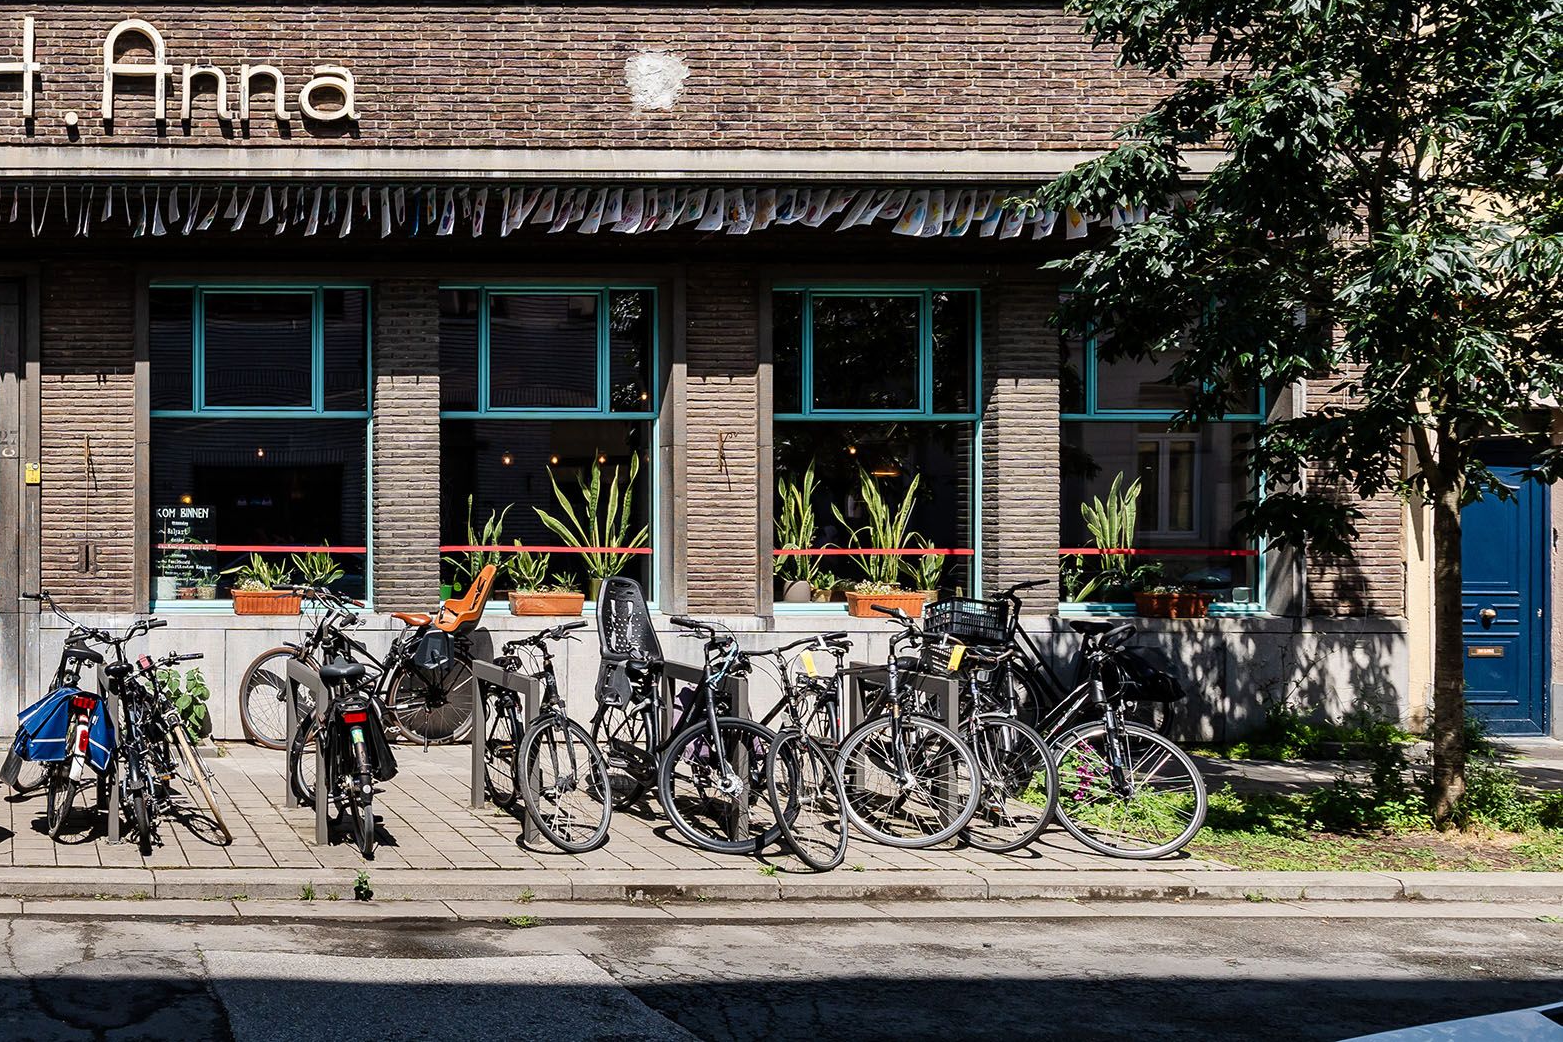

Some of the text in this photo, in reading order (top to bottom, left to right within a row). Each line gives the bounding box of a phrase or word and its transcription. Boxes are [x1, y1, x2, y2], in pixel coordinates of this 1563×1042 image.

[101, 18, 362, 121] Anna
[155, 507, 210, 519] KOM BINNEN
